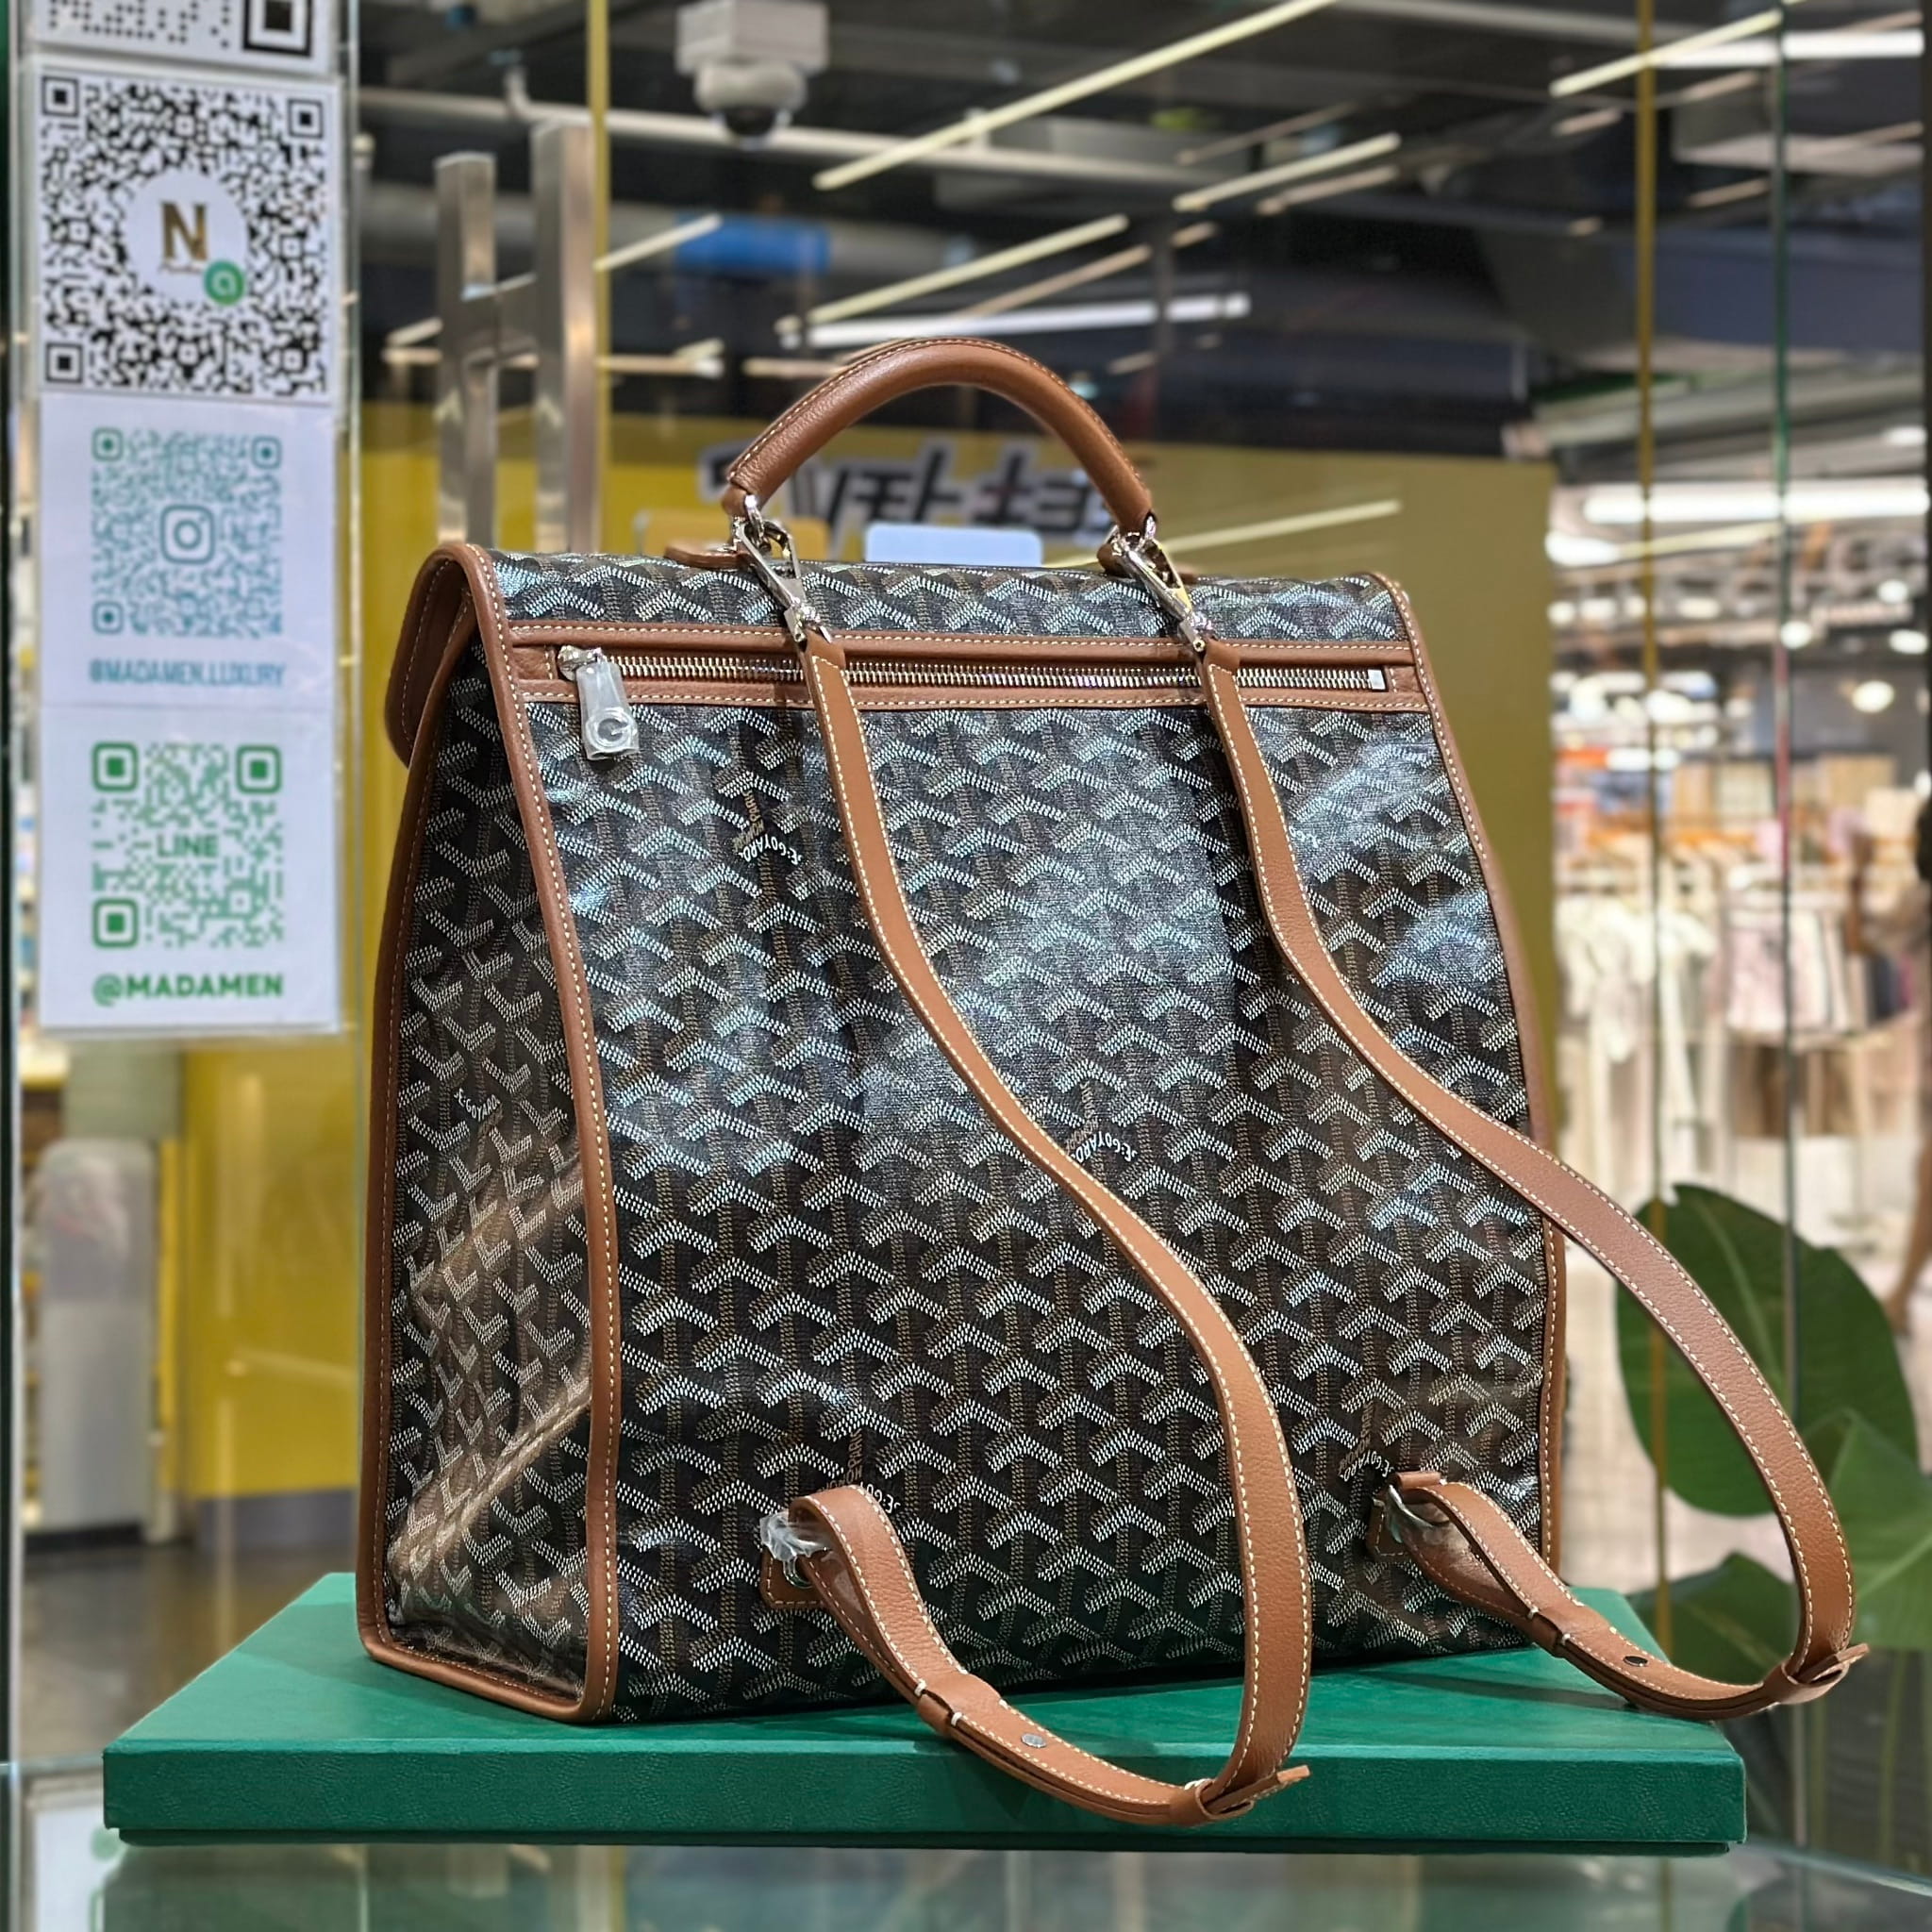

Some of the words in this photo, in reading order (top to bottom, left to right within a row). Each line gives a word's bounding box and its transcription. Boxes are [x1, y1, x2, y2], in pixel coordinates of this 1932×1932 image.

[161, 202, 207, 261] N
[156, 834, 218, 858] LINE
[92, 974, 284, 1007] @MADAMEN
